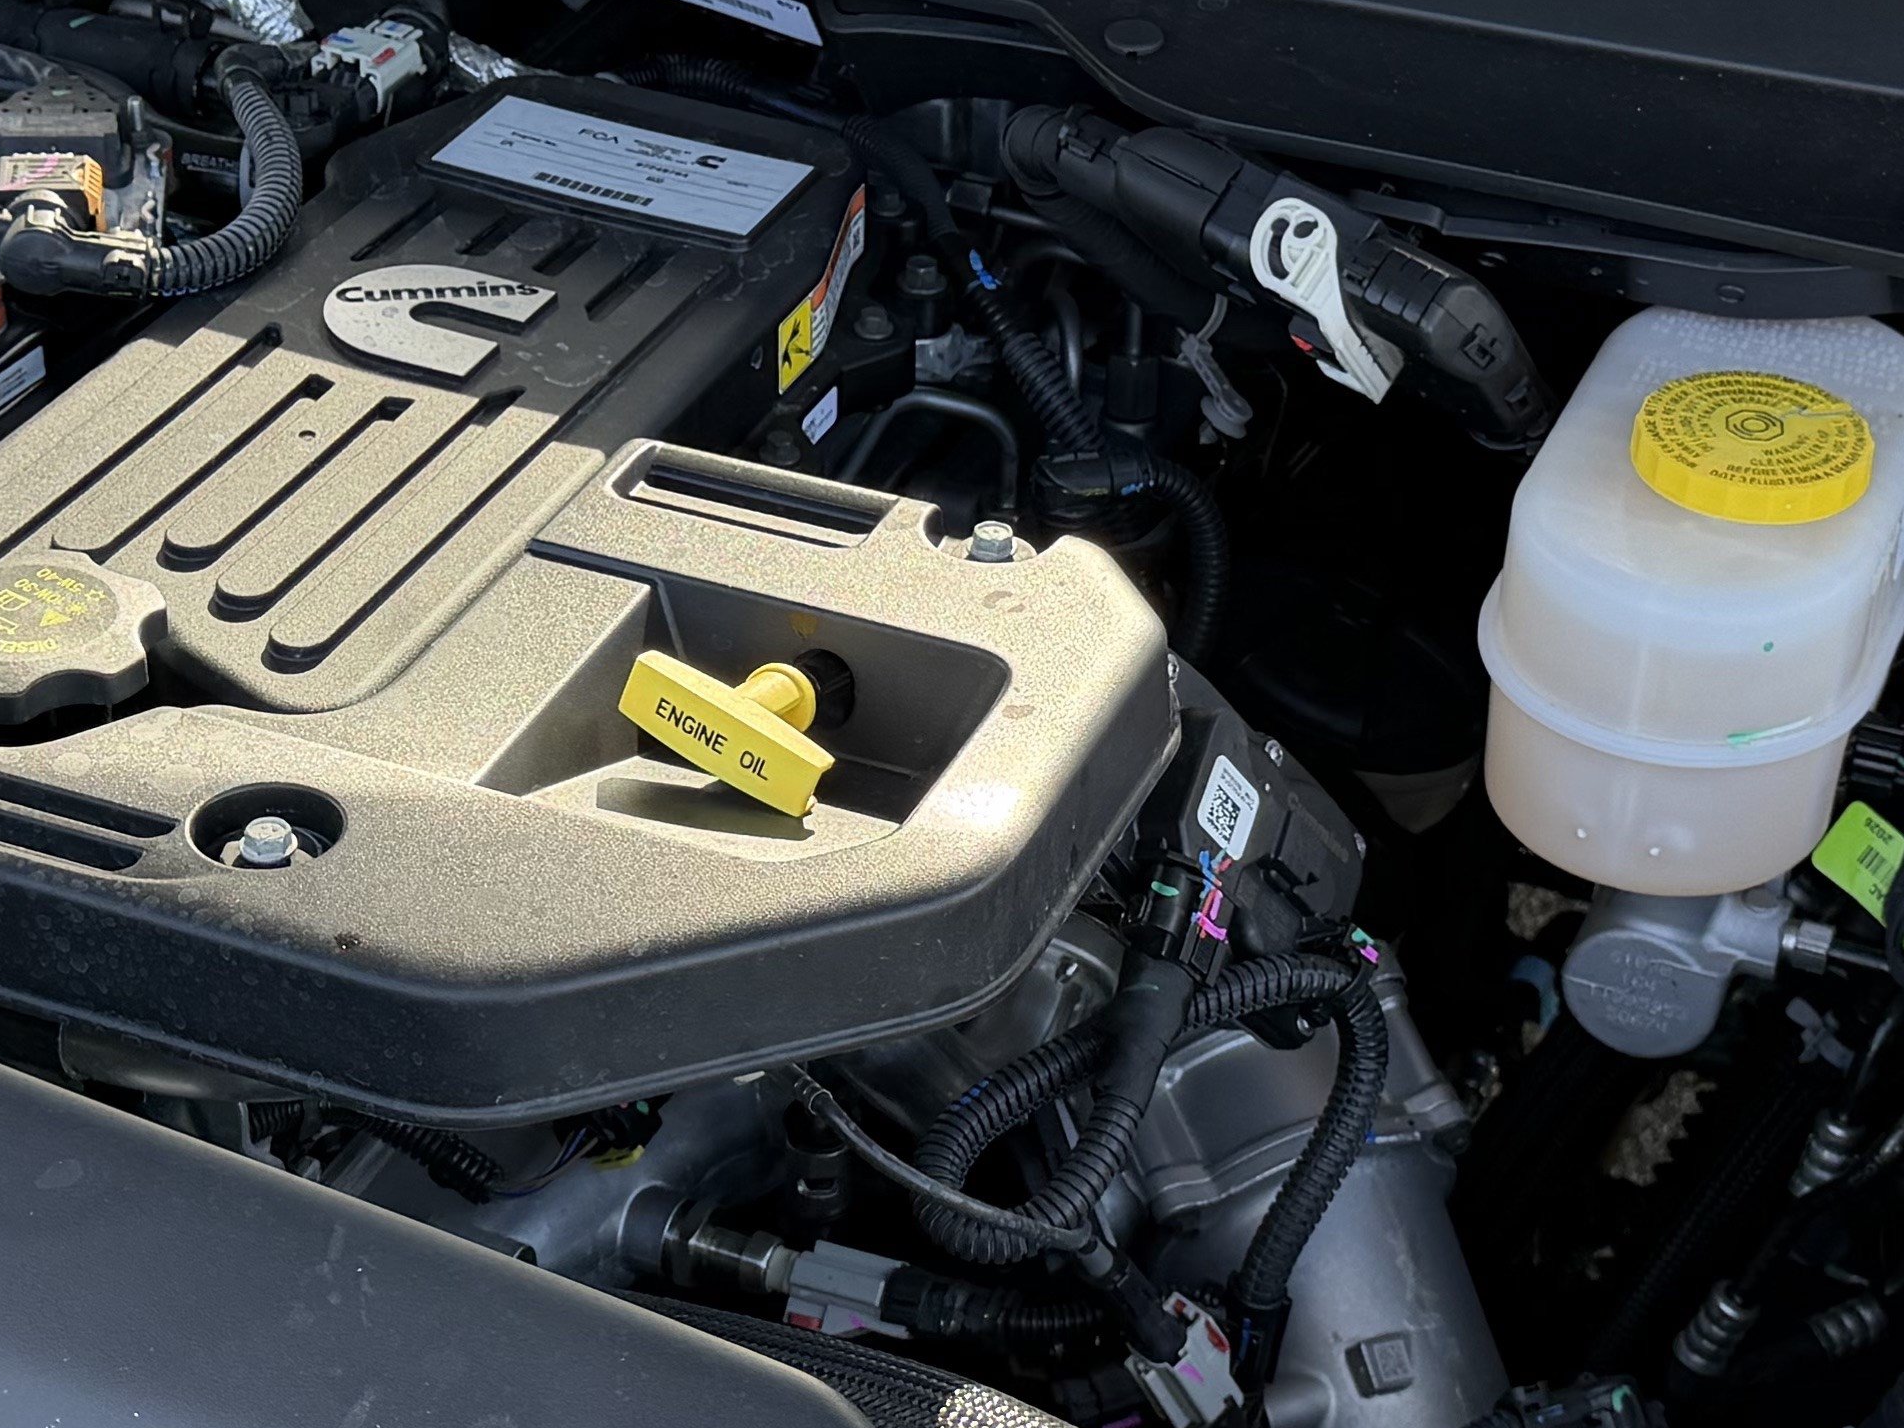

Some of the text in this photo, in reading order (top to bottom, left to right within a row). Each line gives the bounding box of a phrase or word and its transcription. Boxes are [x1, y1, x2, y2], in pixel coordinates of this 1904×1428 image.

[579, 127, 619, 145] FCA
[335, 279, 540, 304] Cummins
[655, 697, 769, 781] ENGINE OIL
